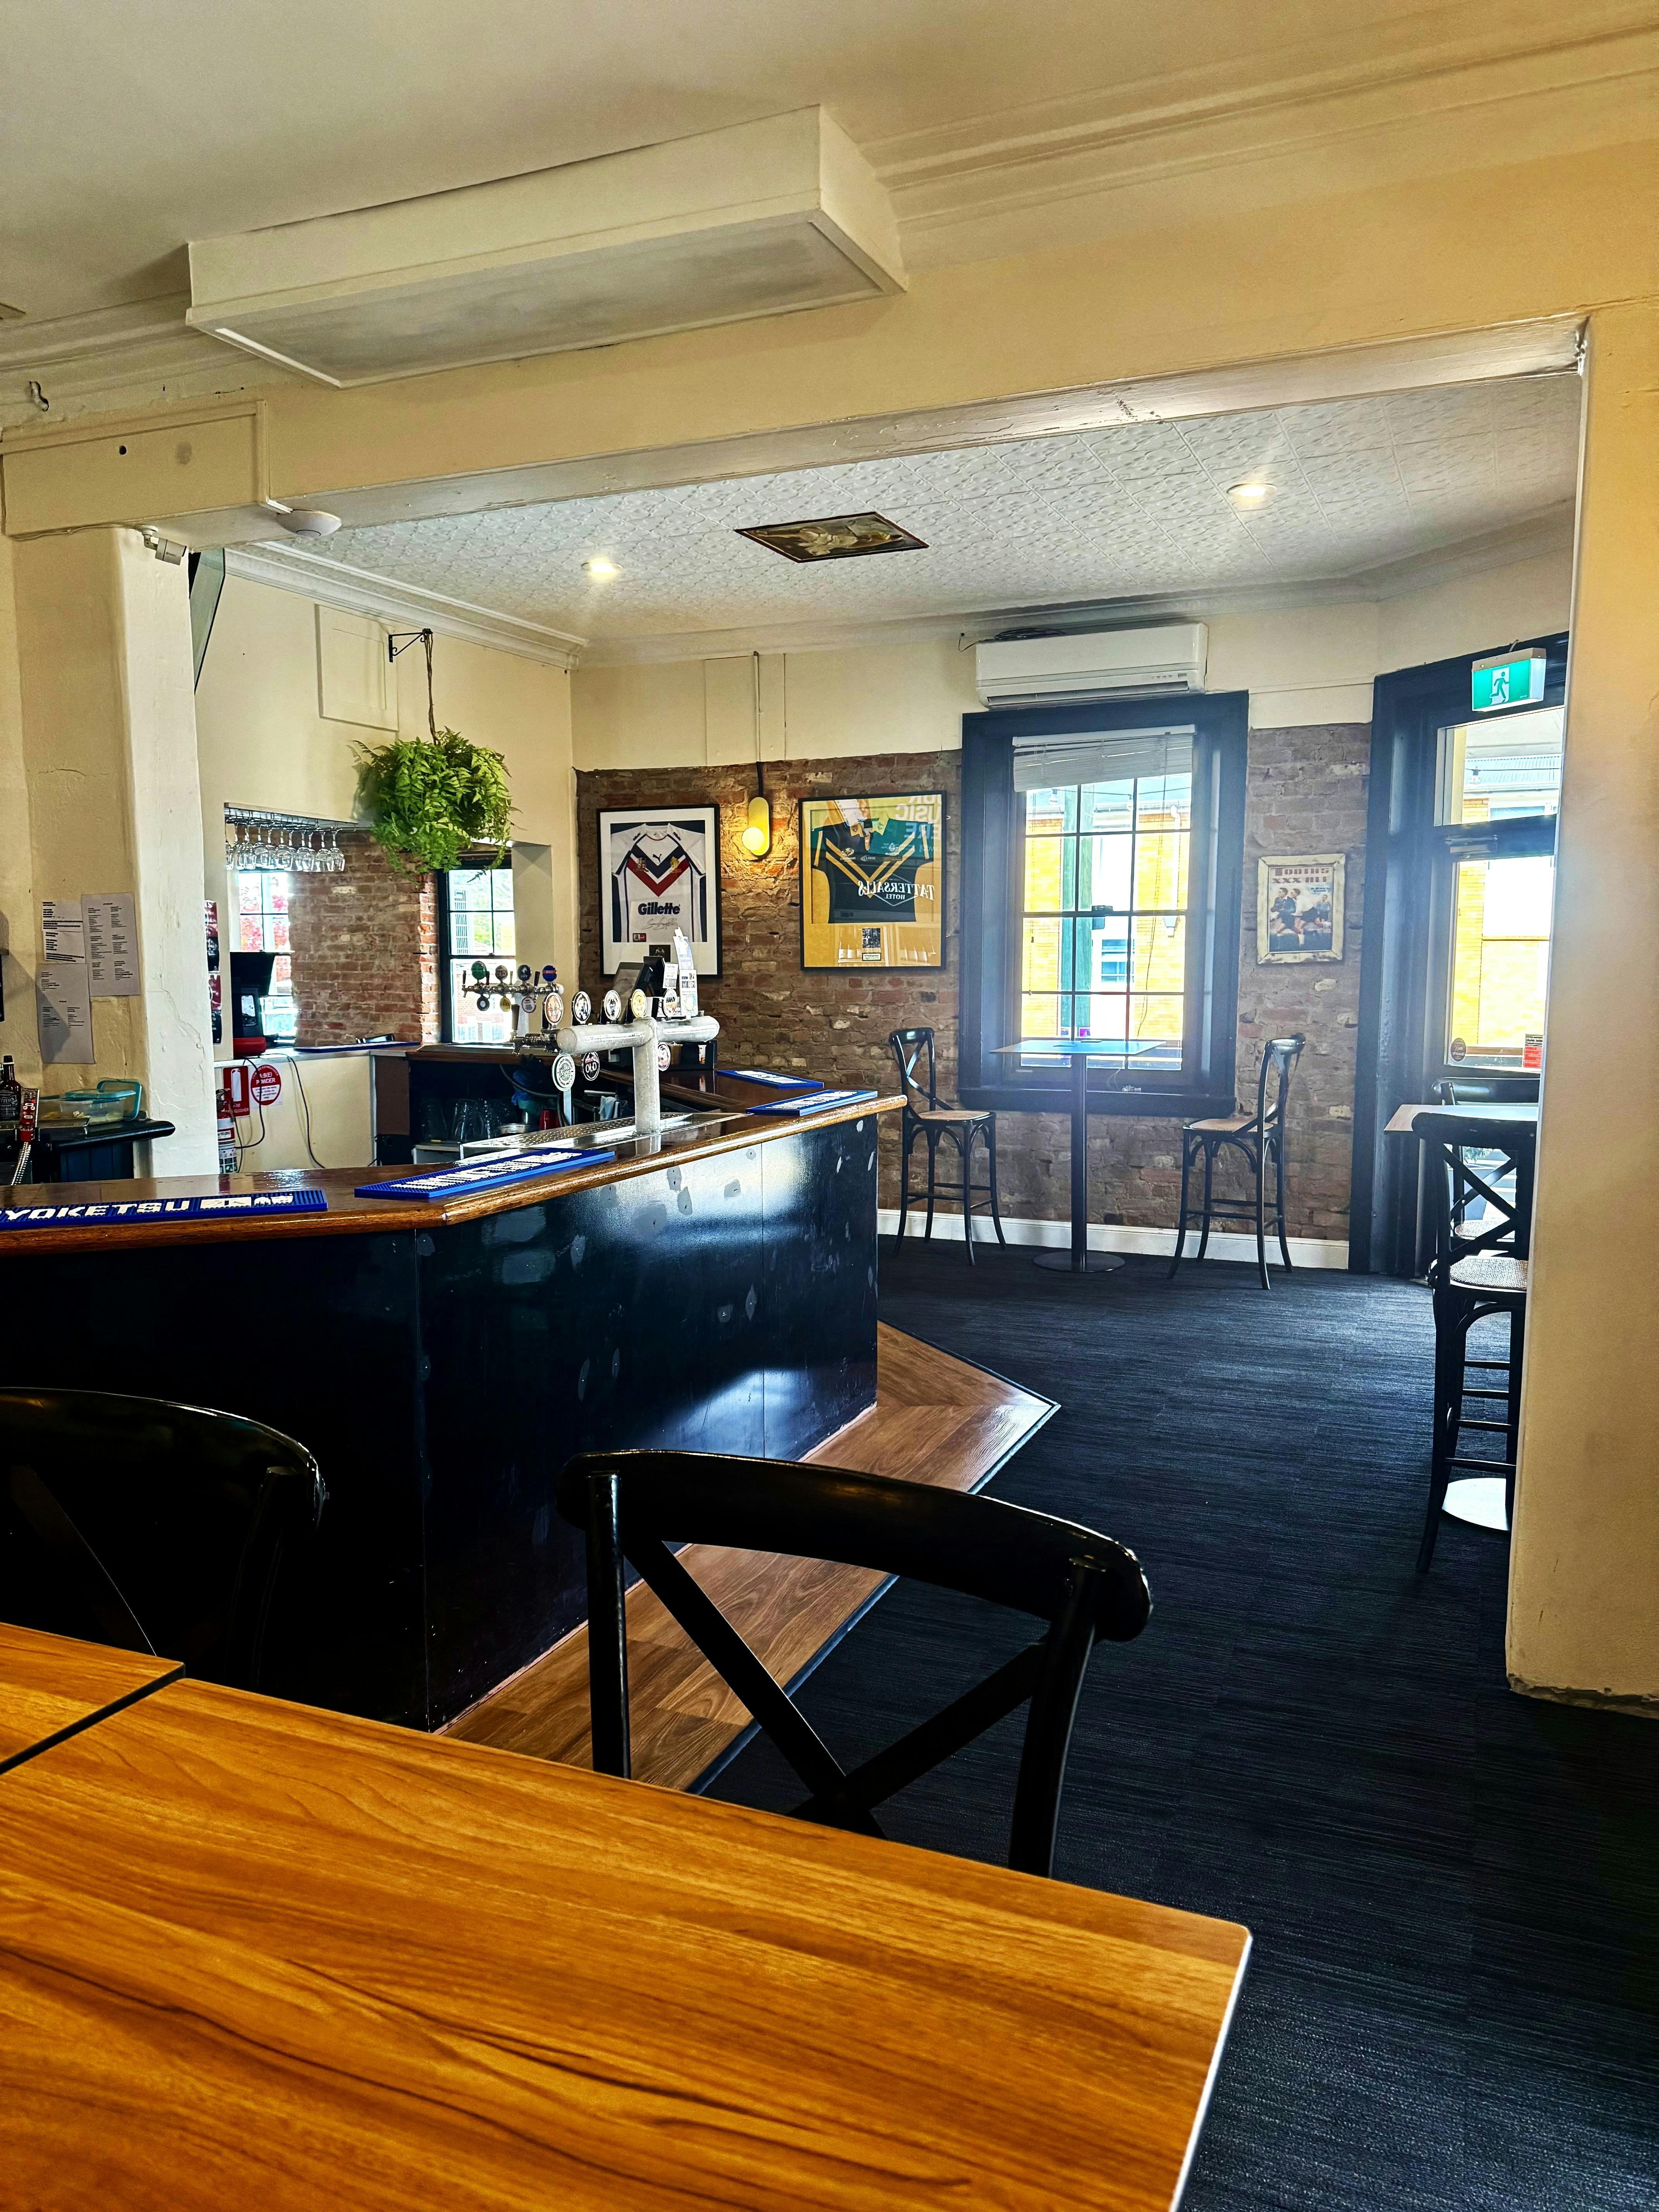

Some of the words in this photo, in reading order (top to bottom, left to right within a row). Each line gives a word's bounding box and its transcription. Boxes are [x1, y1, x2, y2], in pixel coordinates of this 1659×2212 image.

[638, 902, 680, 915] Gillette
[585, 1062, 597, 1073] OLD
[0, 1200, 190, 1221] YOKETSU
